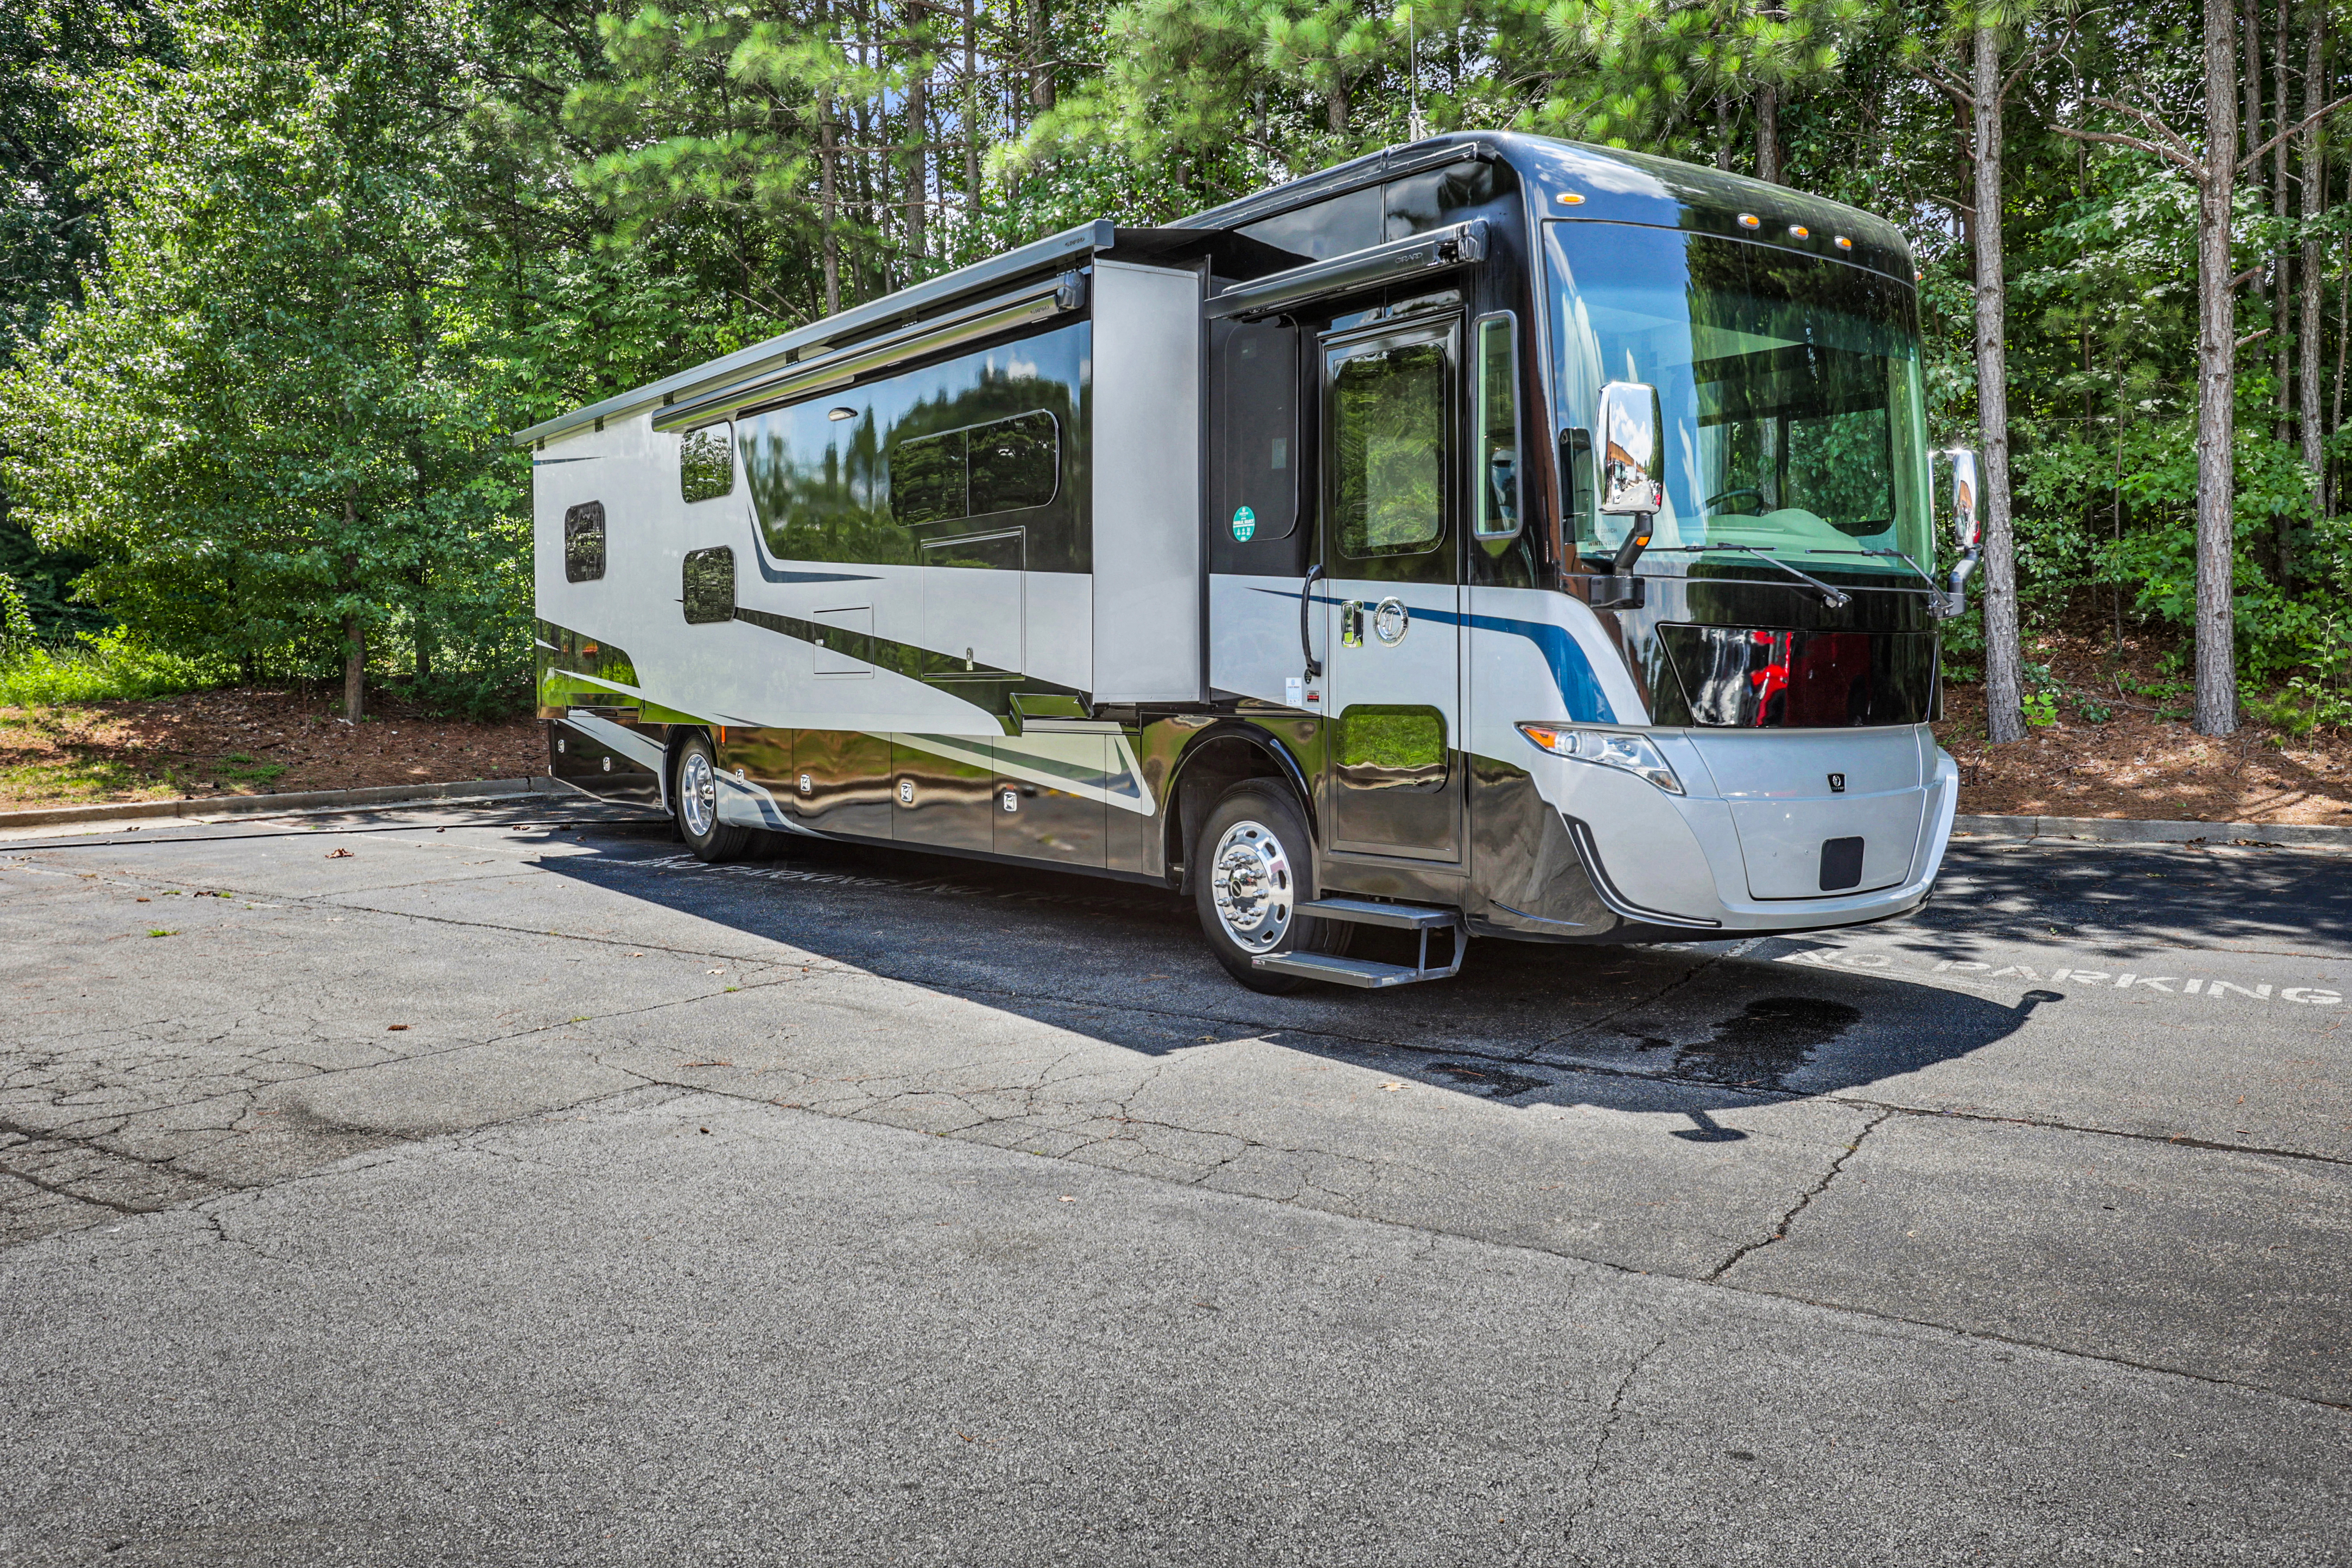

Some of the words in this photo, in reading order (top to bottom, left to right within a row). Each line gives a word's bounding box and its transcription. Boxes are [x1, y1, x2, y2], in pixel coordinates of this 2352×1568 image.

[1395, 252, 1423, 264] GIRARD
[1777, 948, 1890, 966] NO
[1930, 959, 2343, 1005] PARKING
